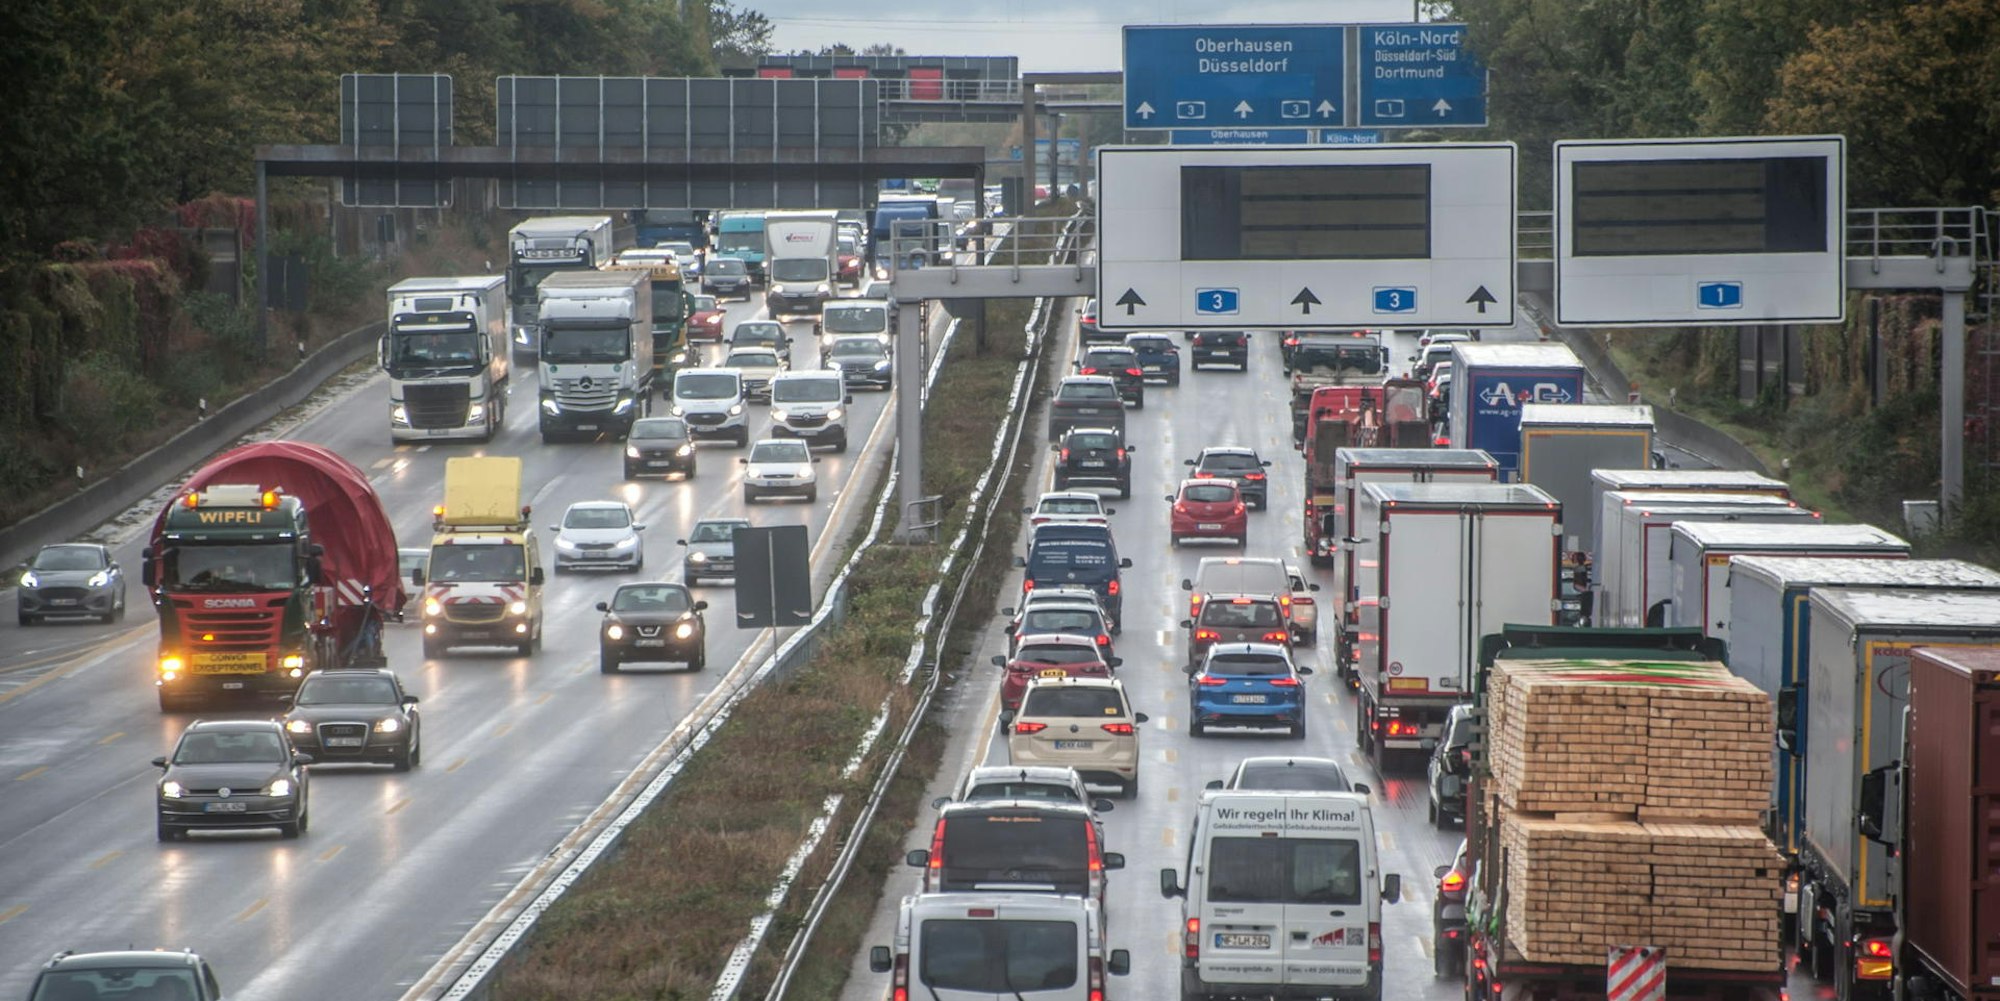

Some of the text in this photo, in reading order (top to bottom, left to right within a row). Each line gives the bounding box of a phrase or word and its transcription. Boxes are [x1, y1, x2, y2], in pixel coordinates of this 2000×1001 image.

[1374, 30, 1459, 46] Köln-Nord
[1195, 37, 1293, 53] Oberhausen
[1375, 49, 1456, 62] Düsseldorf-Süd
[1199, 58, 1288, 73] Düsseldorf
[1375, 66, 1444, 79] Dortmund
[1187, 104, 1195, 116] 3
[1292, 103, 1300, 115] 3
[1387, 102, 1393, 114] 1
[1210, 130, 1268, 139] Oberhausen
[1326, 133, 1377, 144] Köln-Nord
[1212, 293, 1223, 310] 3
[1389, 292, 1400, 308] 3
[1716, 287, 1723, 303] 1
[200, 511, 262, 523] WIPFLI
[204, 598, 256, 609] SCANIA
[1217, 808, 1355, 823] Wir regeln Ihr Klima!
